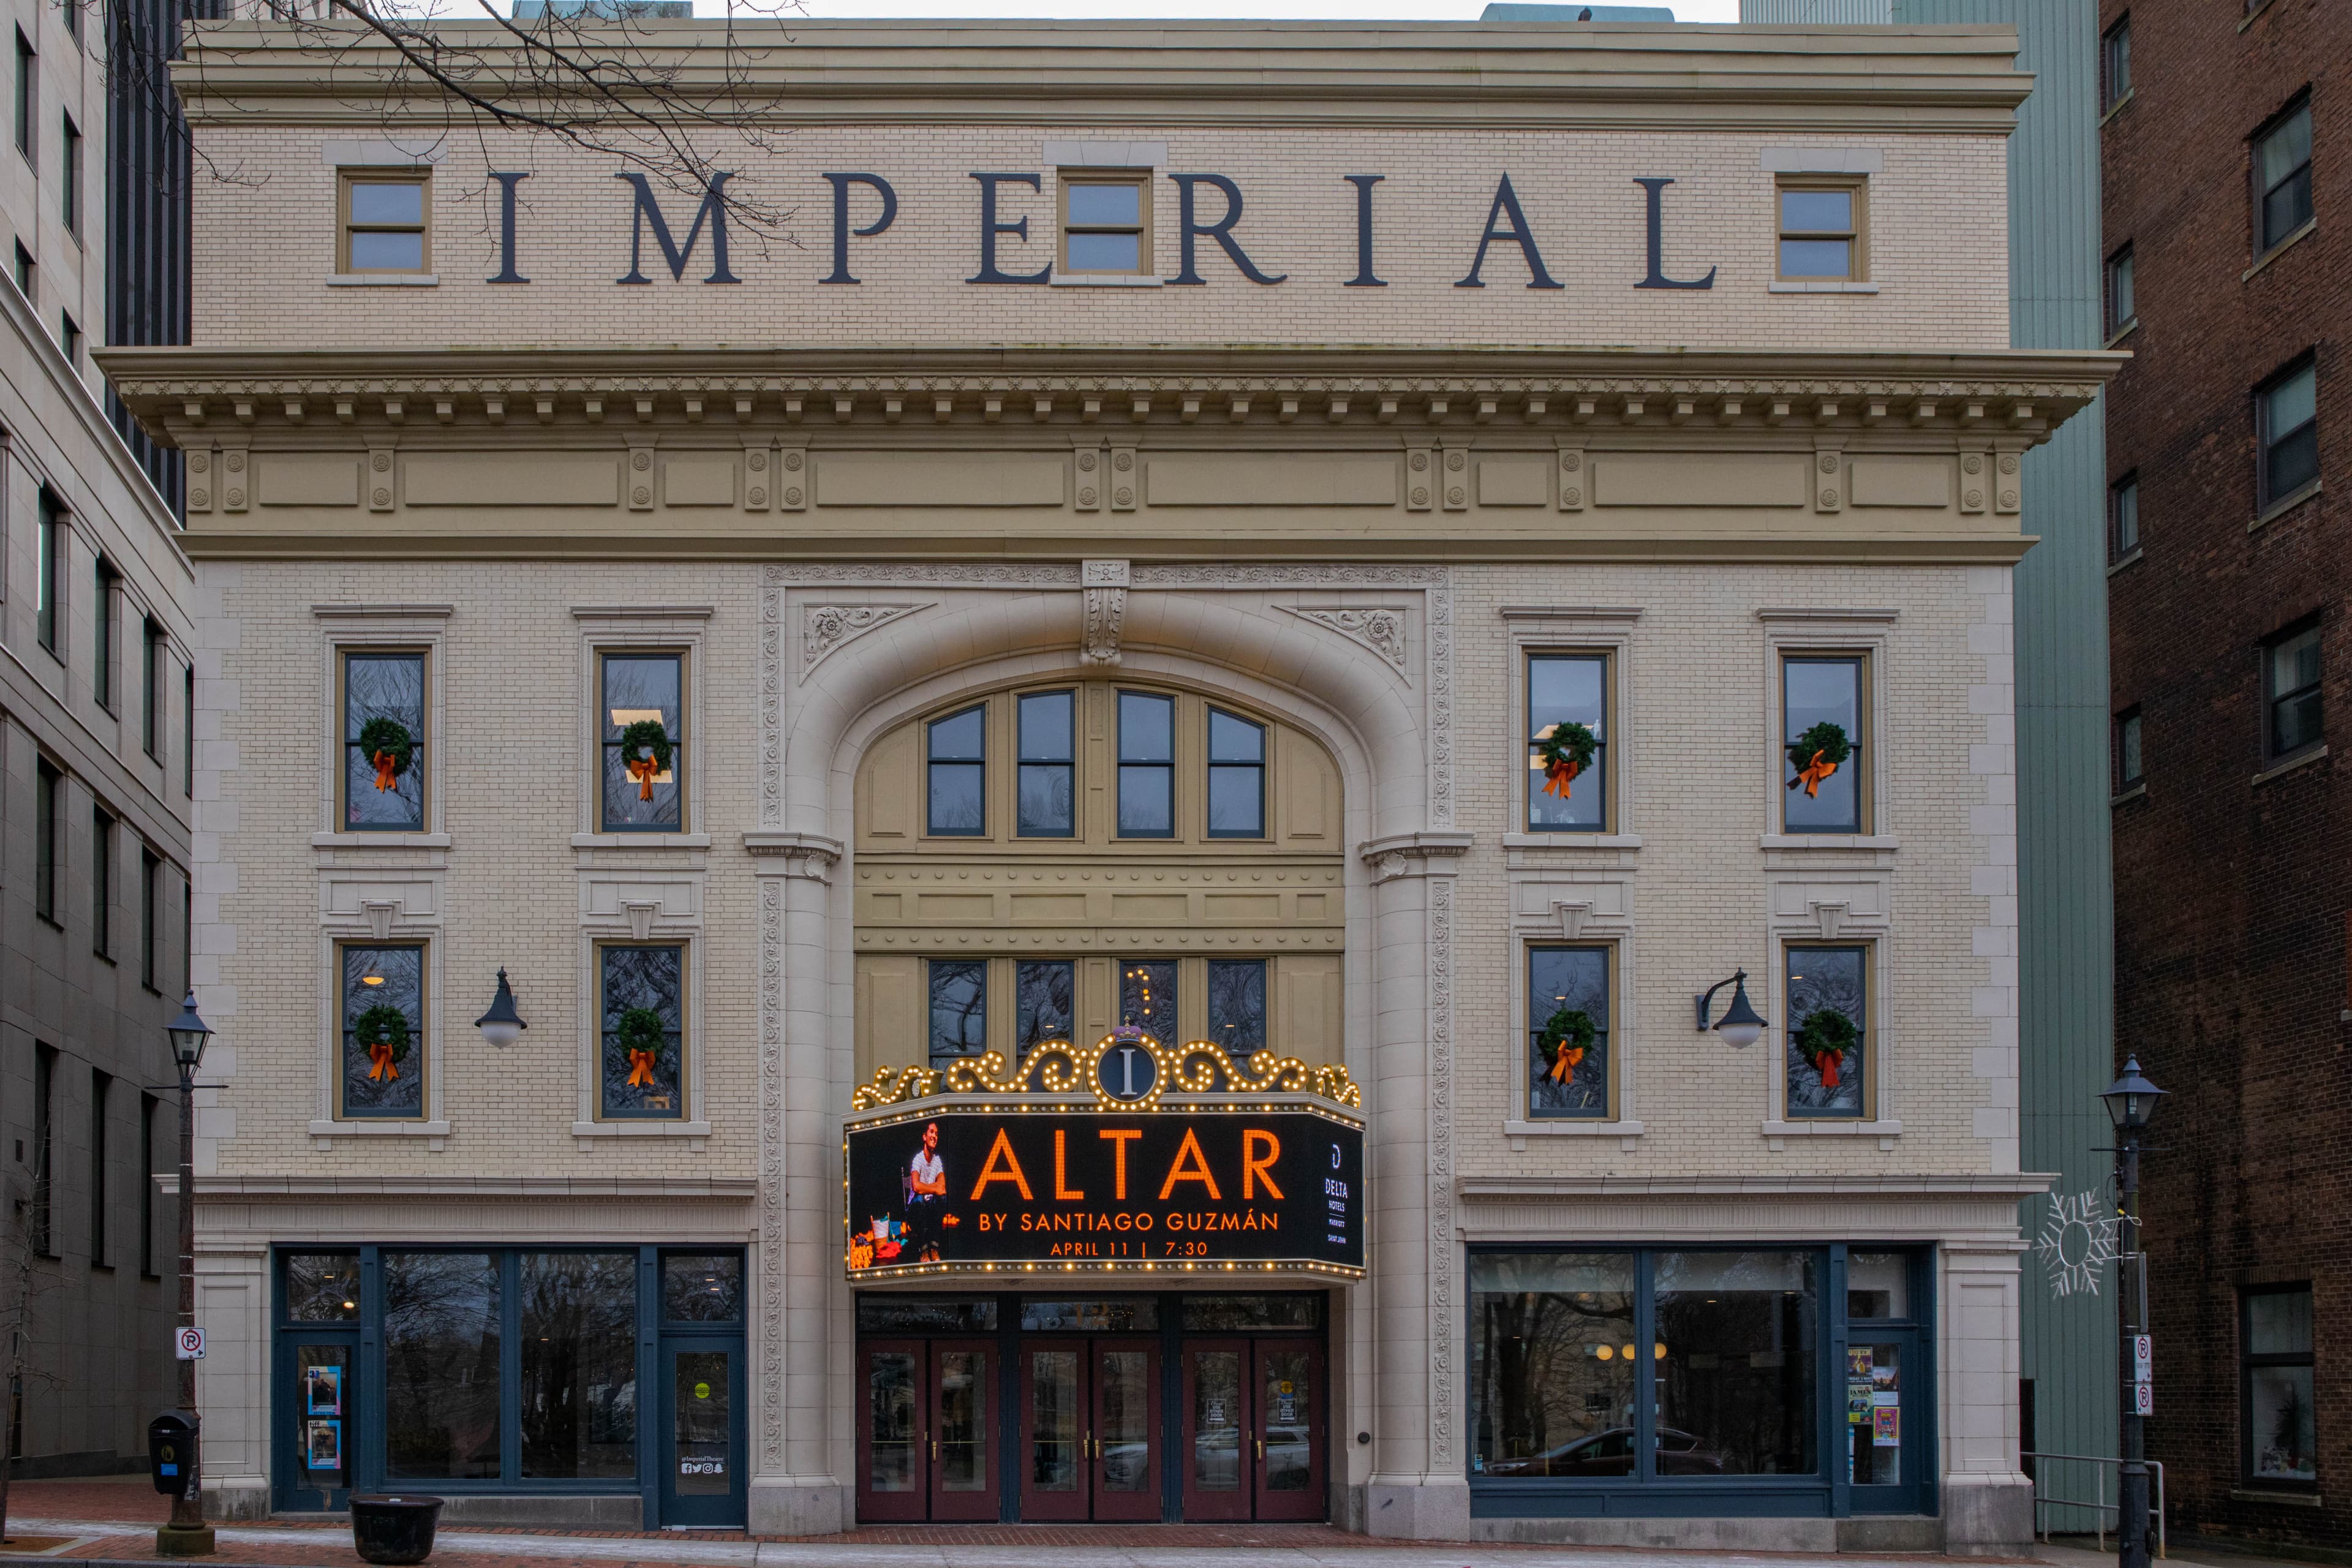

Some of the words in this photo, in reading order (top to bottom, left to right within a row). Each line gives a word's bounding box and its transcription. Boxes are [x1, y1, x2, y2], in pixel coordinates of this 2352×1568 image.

[486, 170, 1716, 289] IMPERIAL
[1120, 1049, 1137, 1095] I
[970, 1127, 1284, 1200] ALTAR
[1325, 1177, 1348, 1199] DELTA
[1329, 1200, 1345, 1213] HOTELS
[980, 1213, 1008, 1231] BY
[1020, 1213, 1153, 1232] SANTIAGO
[1166, 1208, 1278, 1231] GUZMÁN
[1050, 1242, 1098, 1256] APRIL
[1109, 1242, 1128, 1256] 11
[1166, 1242, 1207, 1256] 7:30
